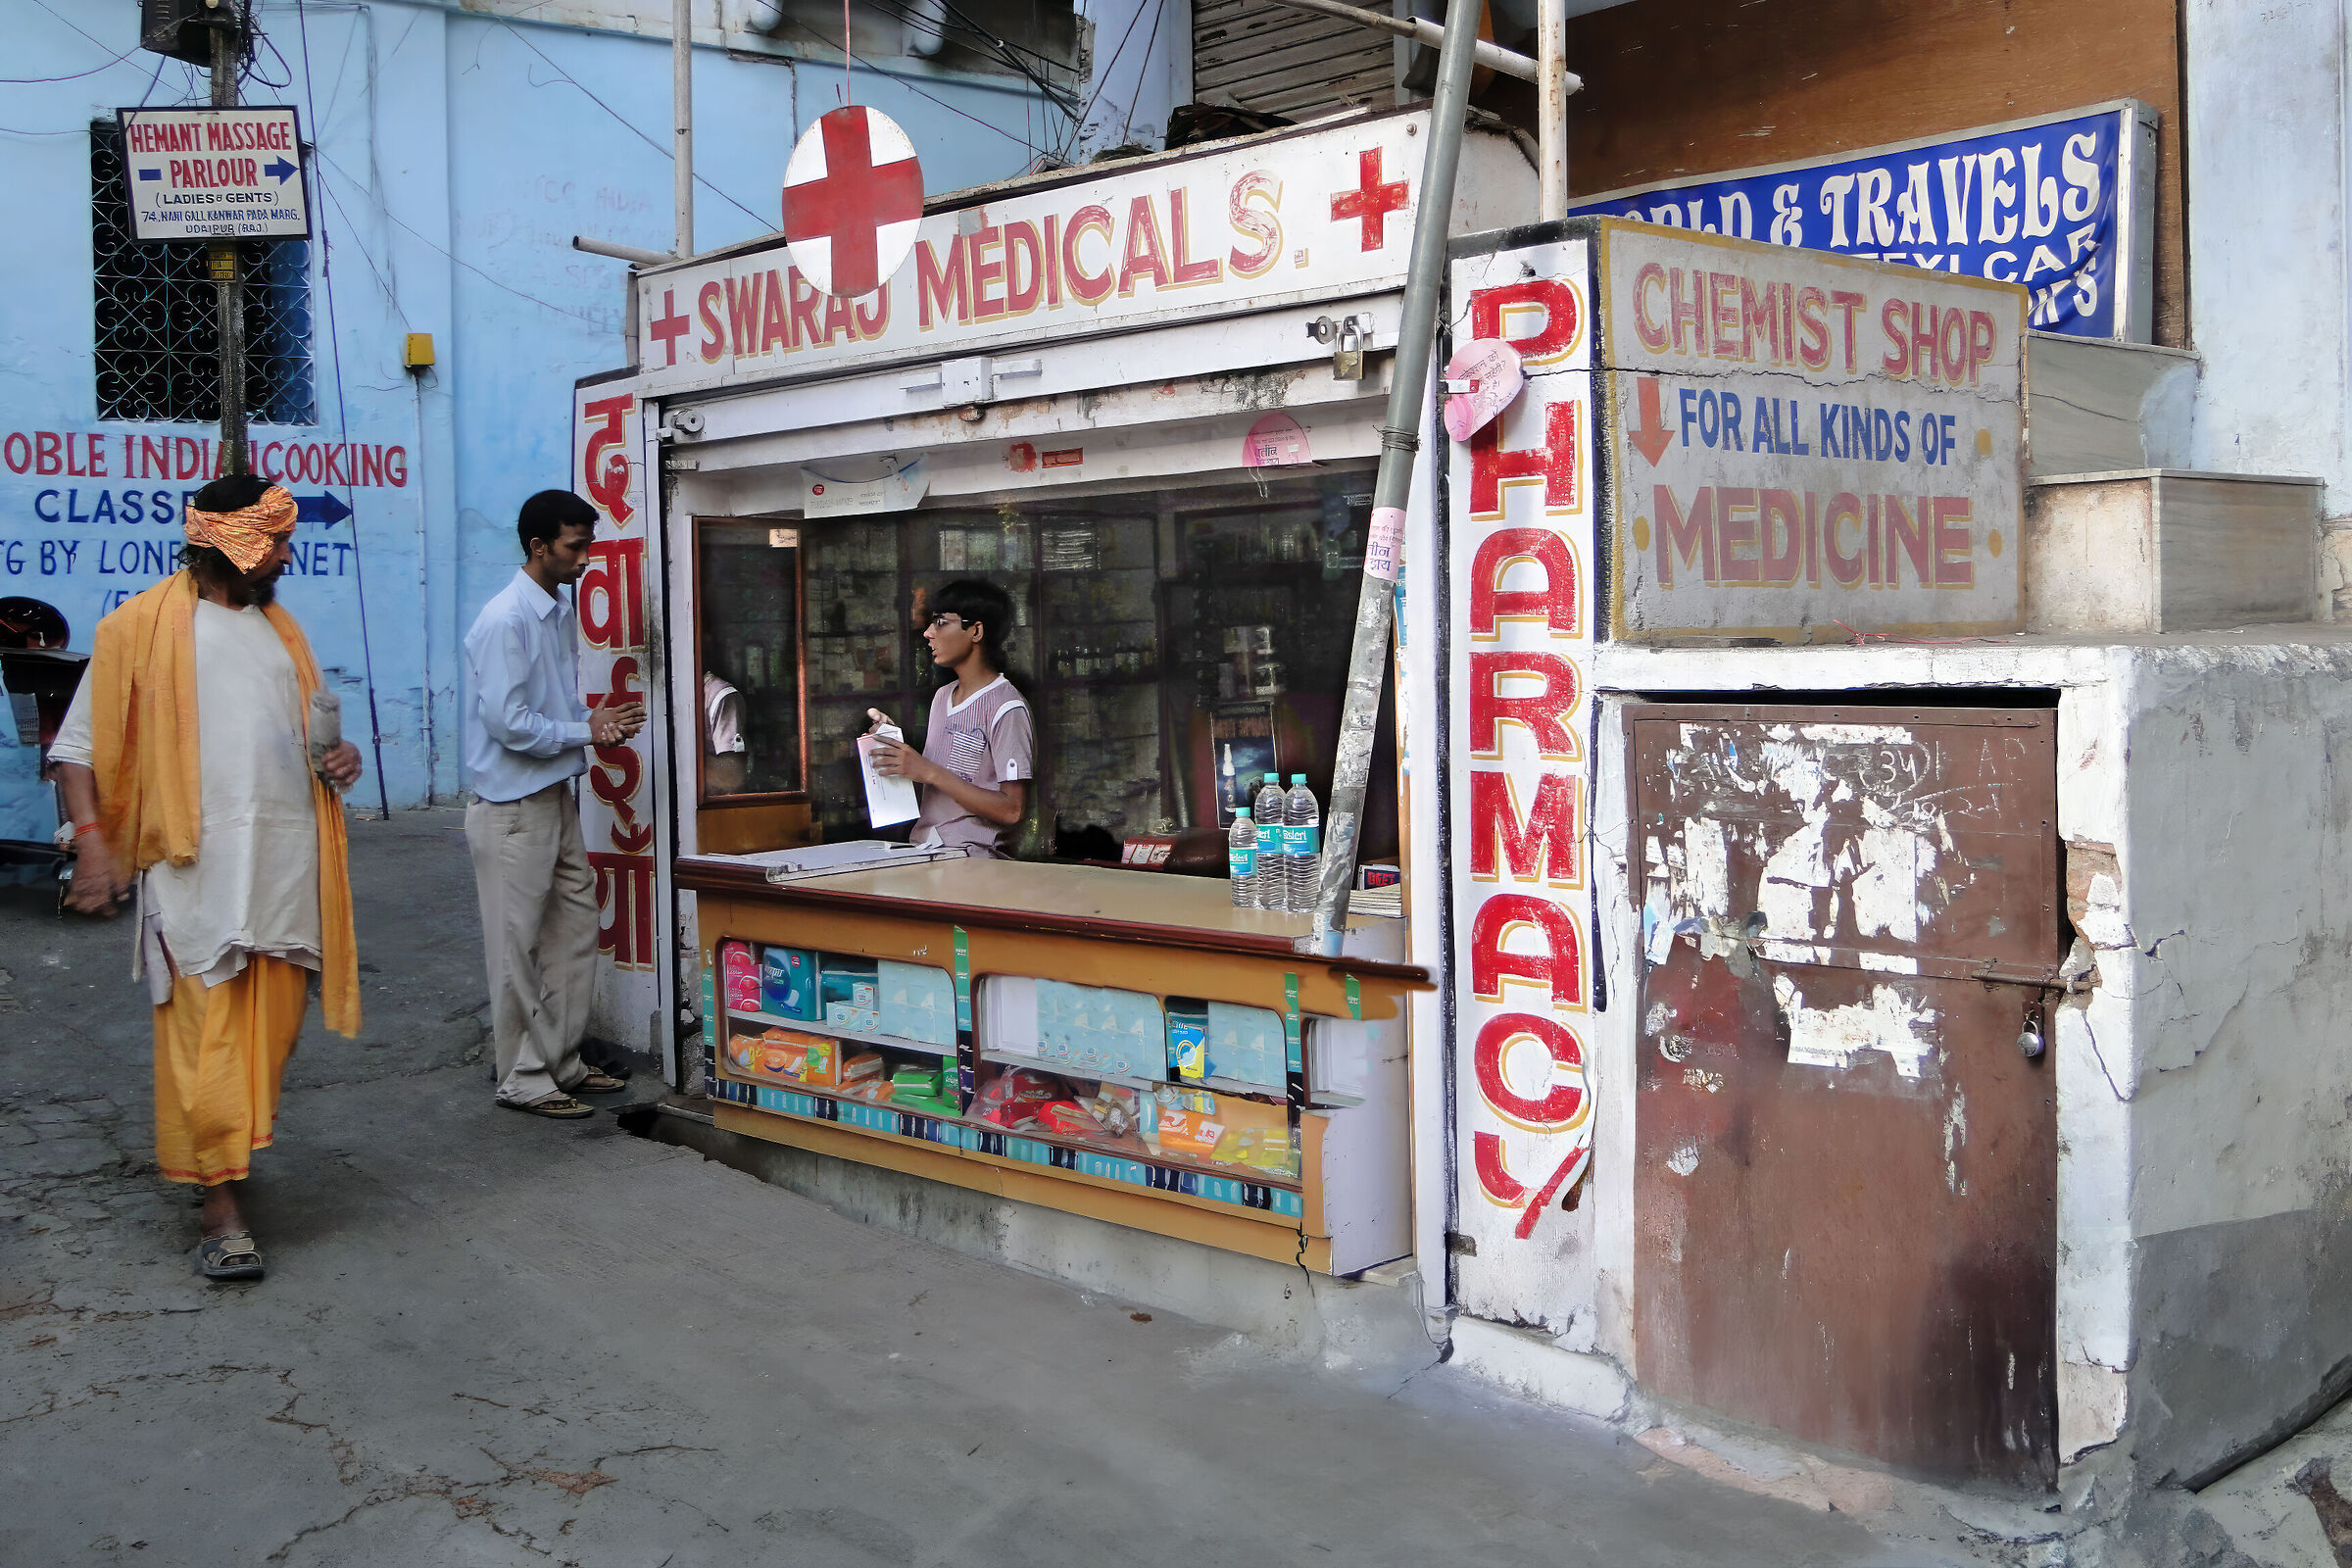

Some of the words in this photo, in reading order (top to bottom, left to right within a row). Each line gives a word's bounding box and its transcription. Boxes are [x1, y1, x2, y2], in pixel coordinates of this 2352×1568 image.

[128, 122, 202, 153] HEMANT
[207, 122, 292, 151] MASSAGE
[170, 158, 259, 188] PARLOUR
[1771, 183, 1803, 248] &
[1821, 131, 2100, 248] TRAVELS
[698, 265, 892, 365] SWARAJ
[1634, 263, 1867, 375] CHEMIST
[1881, 298, 1997, 388] SHOP
[262, 441, 408, 488] COOKING
[1679, 387, 1742, 452] FOR
[1752, 396, 1810, 456] ALL
[1820, 402, 1911, 463] KINDS
[1920, 412, 1956, 466] OF
[40, 540, 81, 576] BY
[1653, 484, 1975, 590] MEDICINE
[1468, 278, 1590, 1241] PHARMACY
